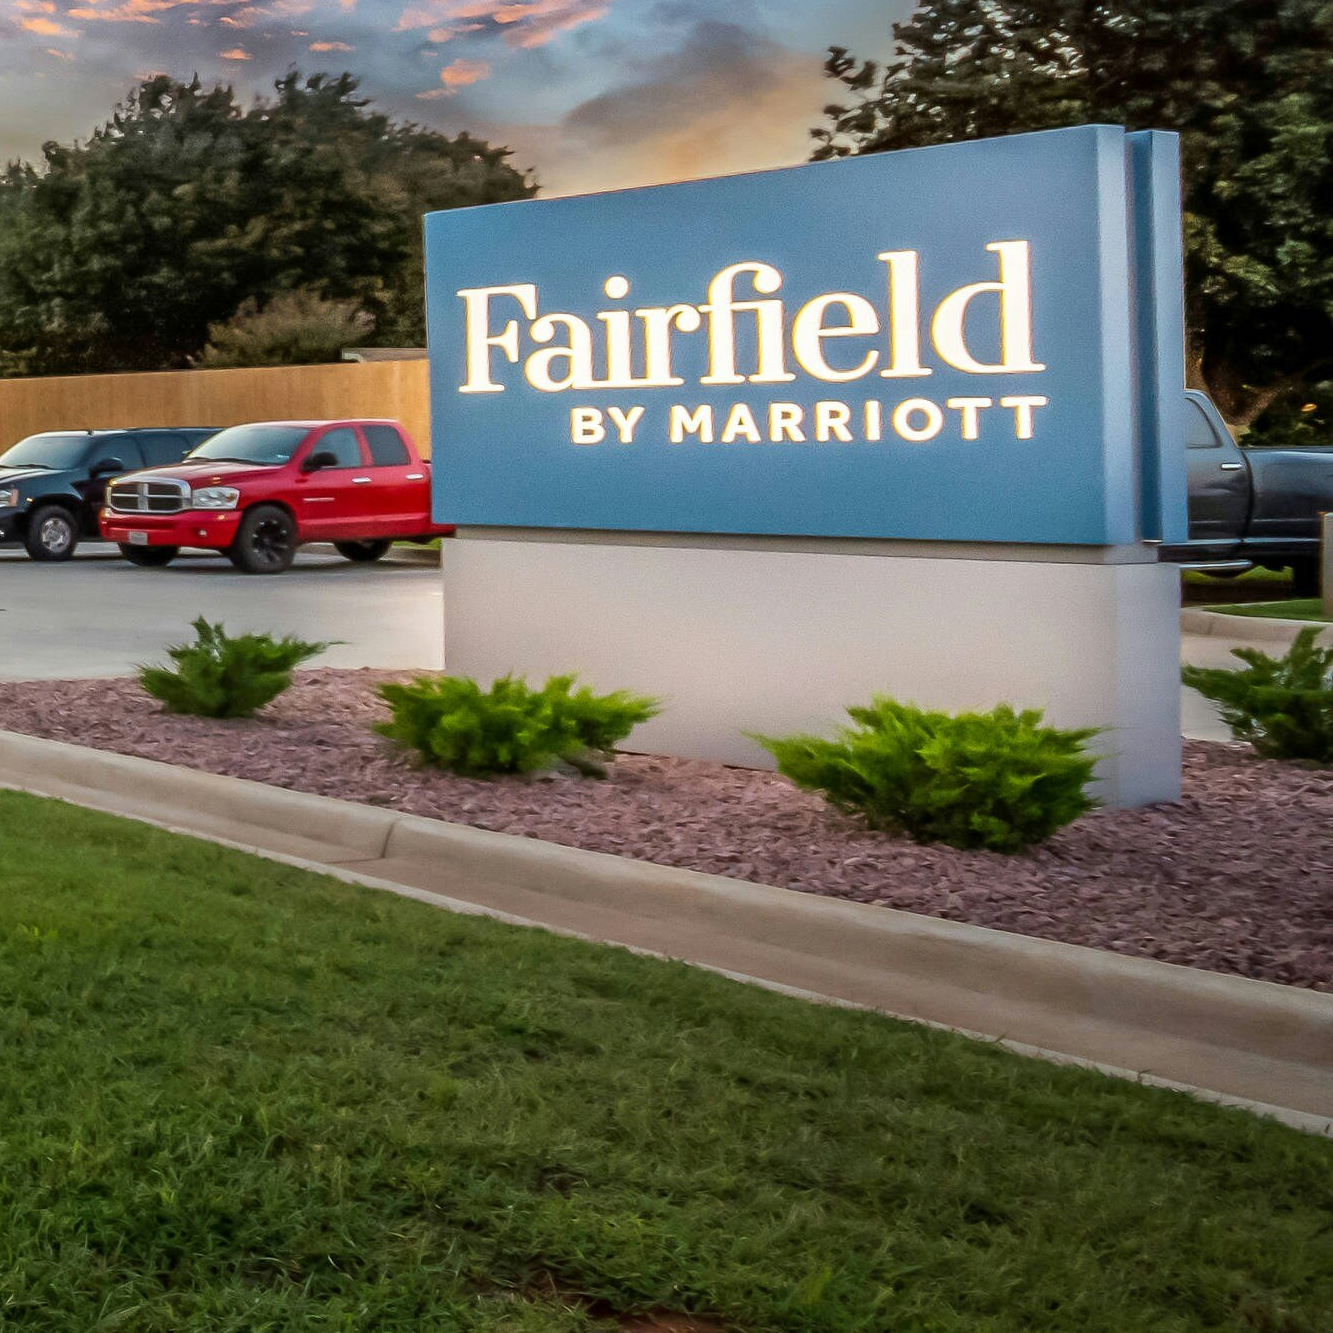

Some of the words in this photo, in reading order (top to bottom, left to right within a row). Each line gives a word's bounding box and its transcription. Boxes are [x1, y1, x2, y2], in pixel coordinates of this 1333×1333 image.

[454, 239, 1047, 395] Fairfield
[569, 405, 646, 446] BY
[668, 394, 1049, 445] MARRIOTT
